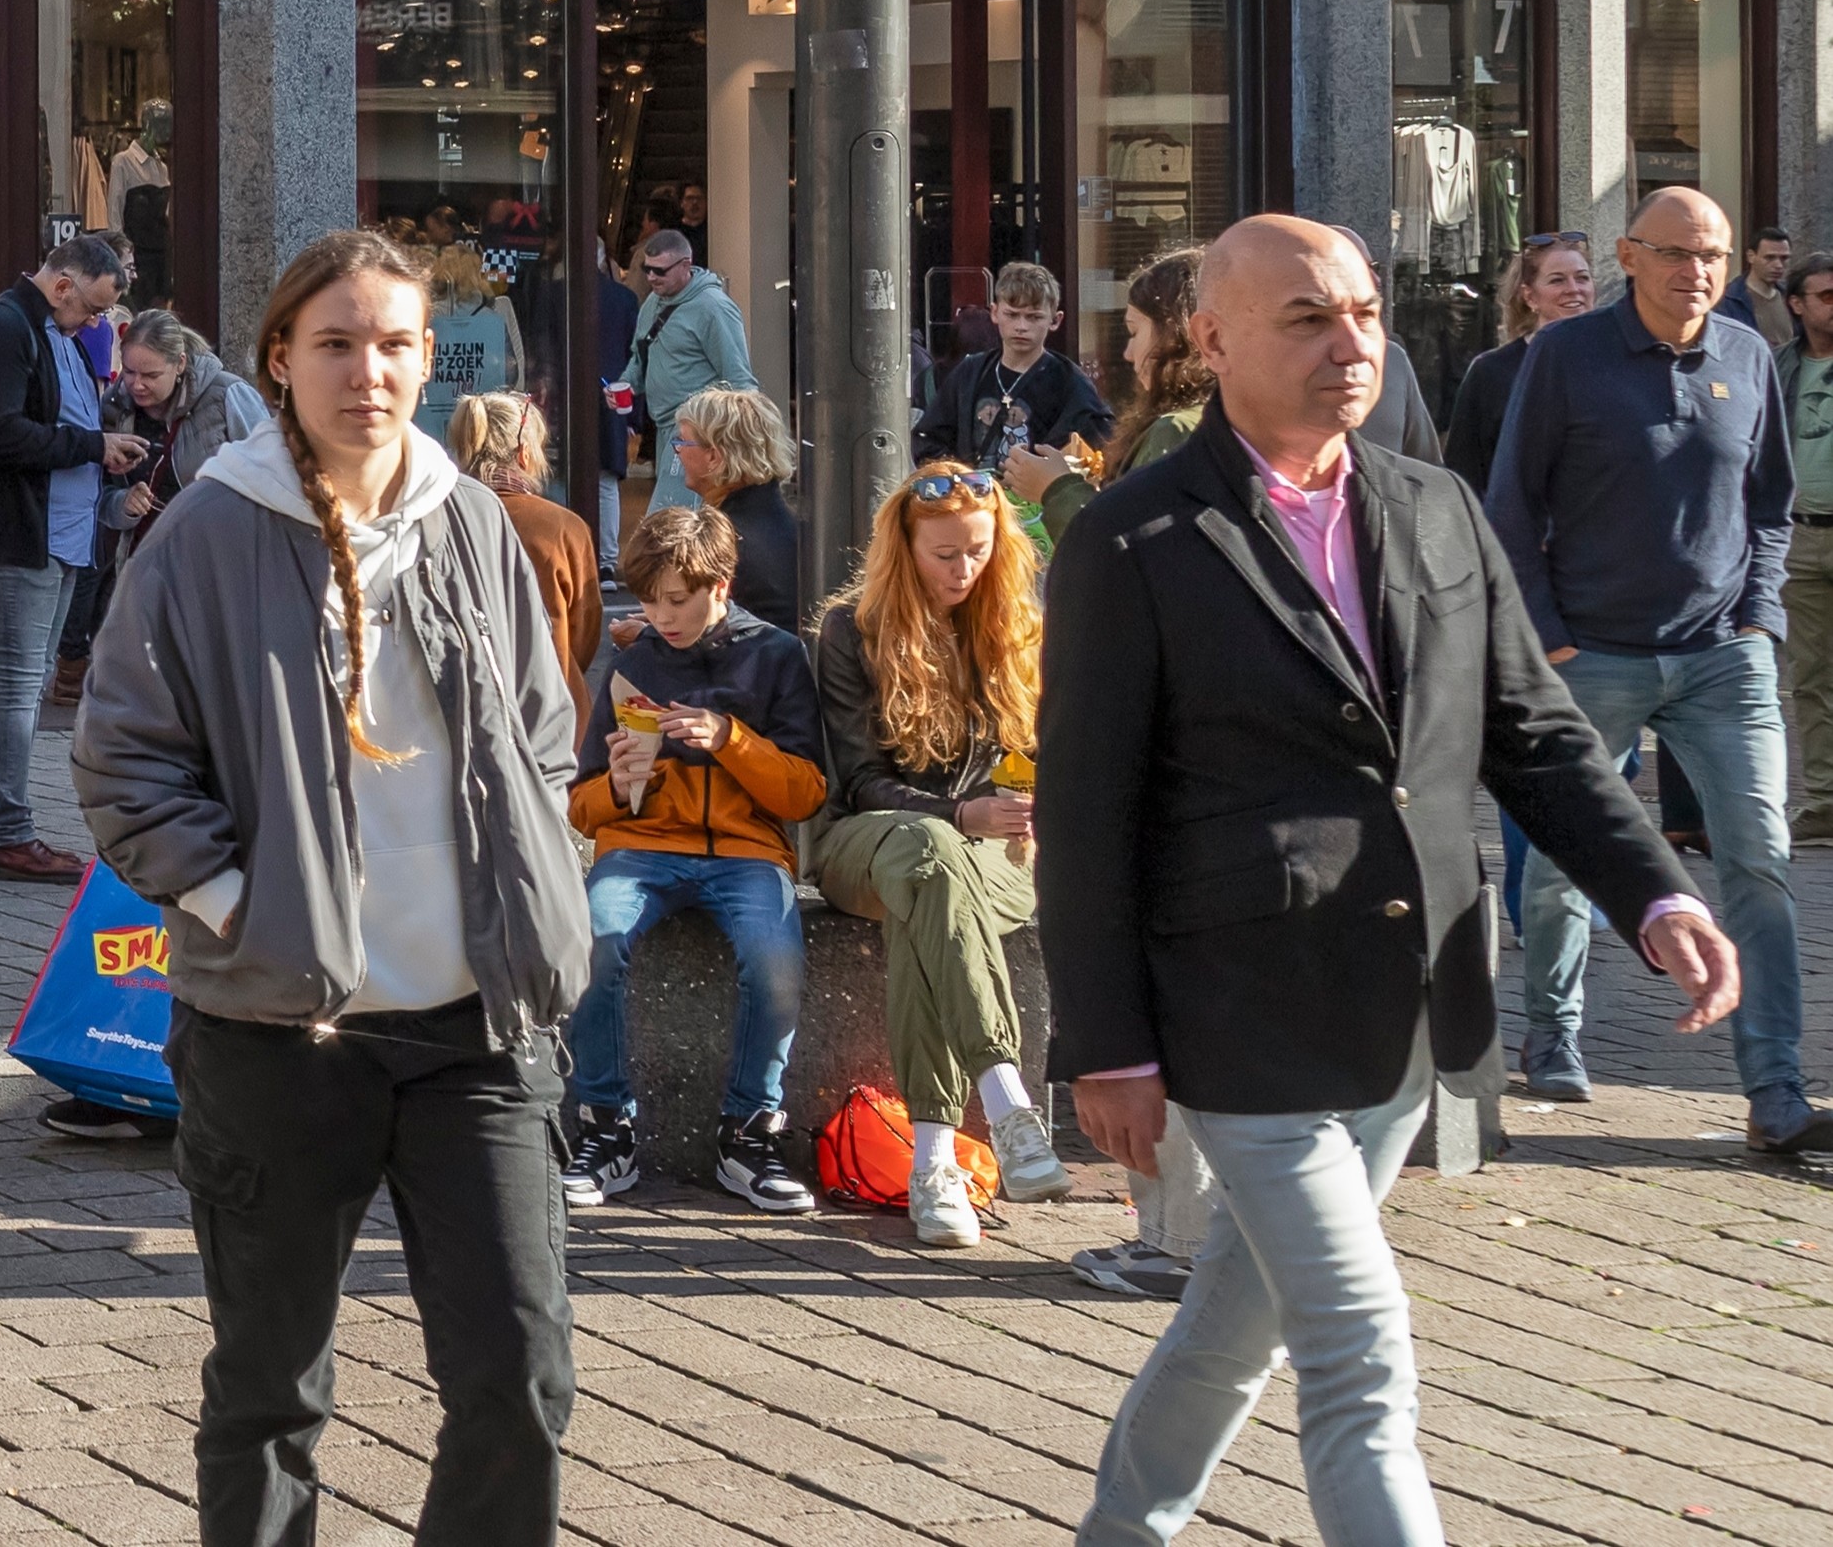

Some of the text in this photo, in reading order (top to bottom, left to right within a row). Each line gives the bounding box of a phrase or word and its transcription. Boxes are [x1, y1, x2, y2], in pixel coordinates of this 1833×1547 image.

[52, 220, 76, 247] 19
[453, 342, 484, 356] ZIJN
[446, 356, 484, 369] ZOEK
[435, 371, 475, 384] NAAR
